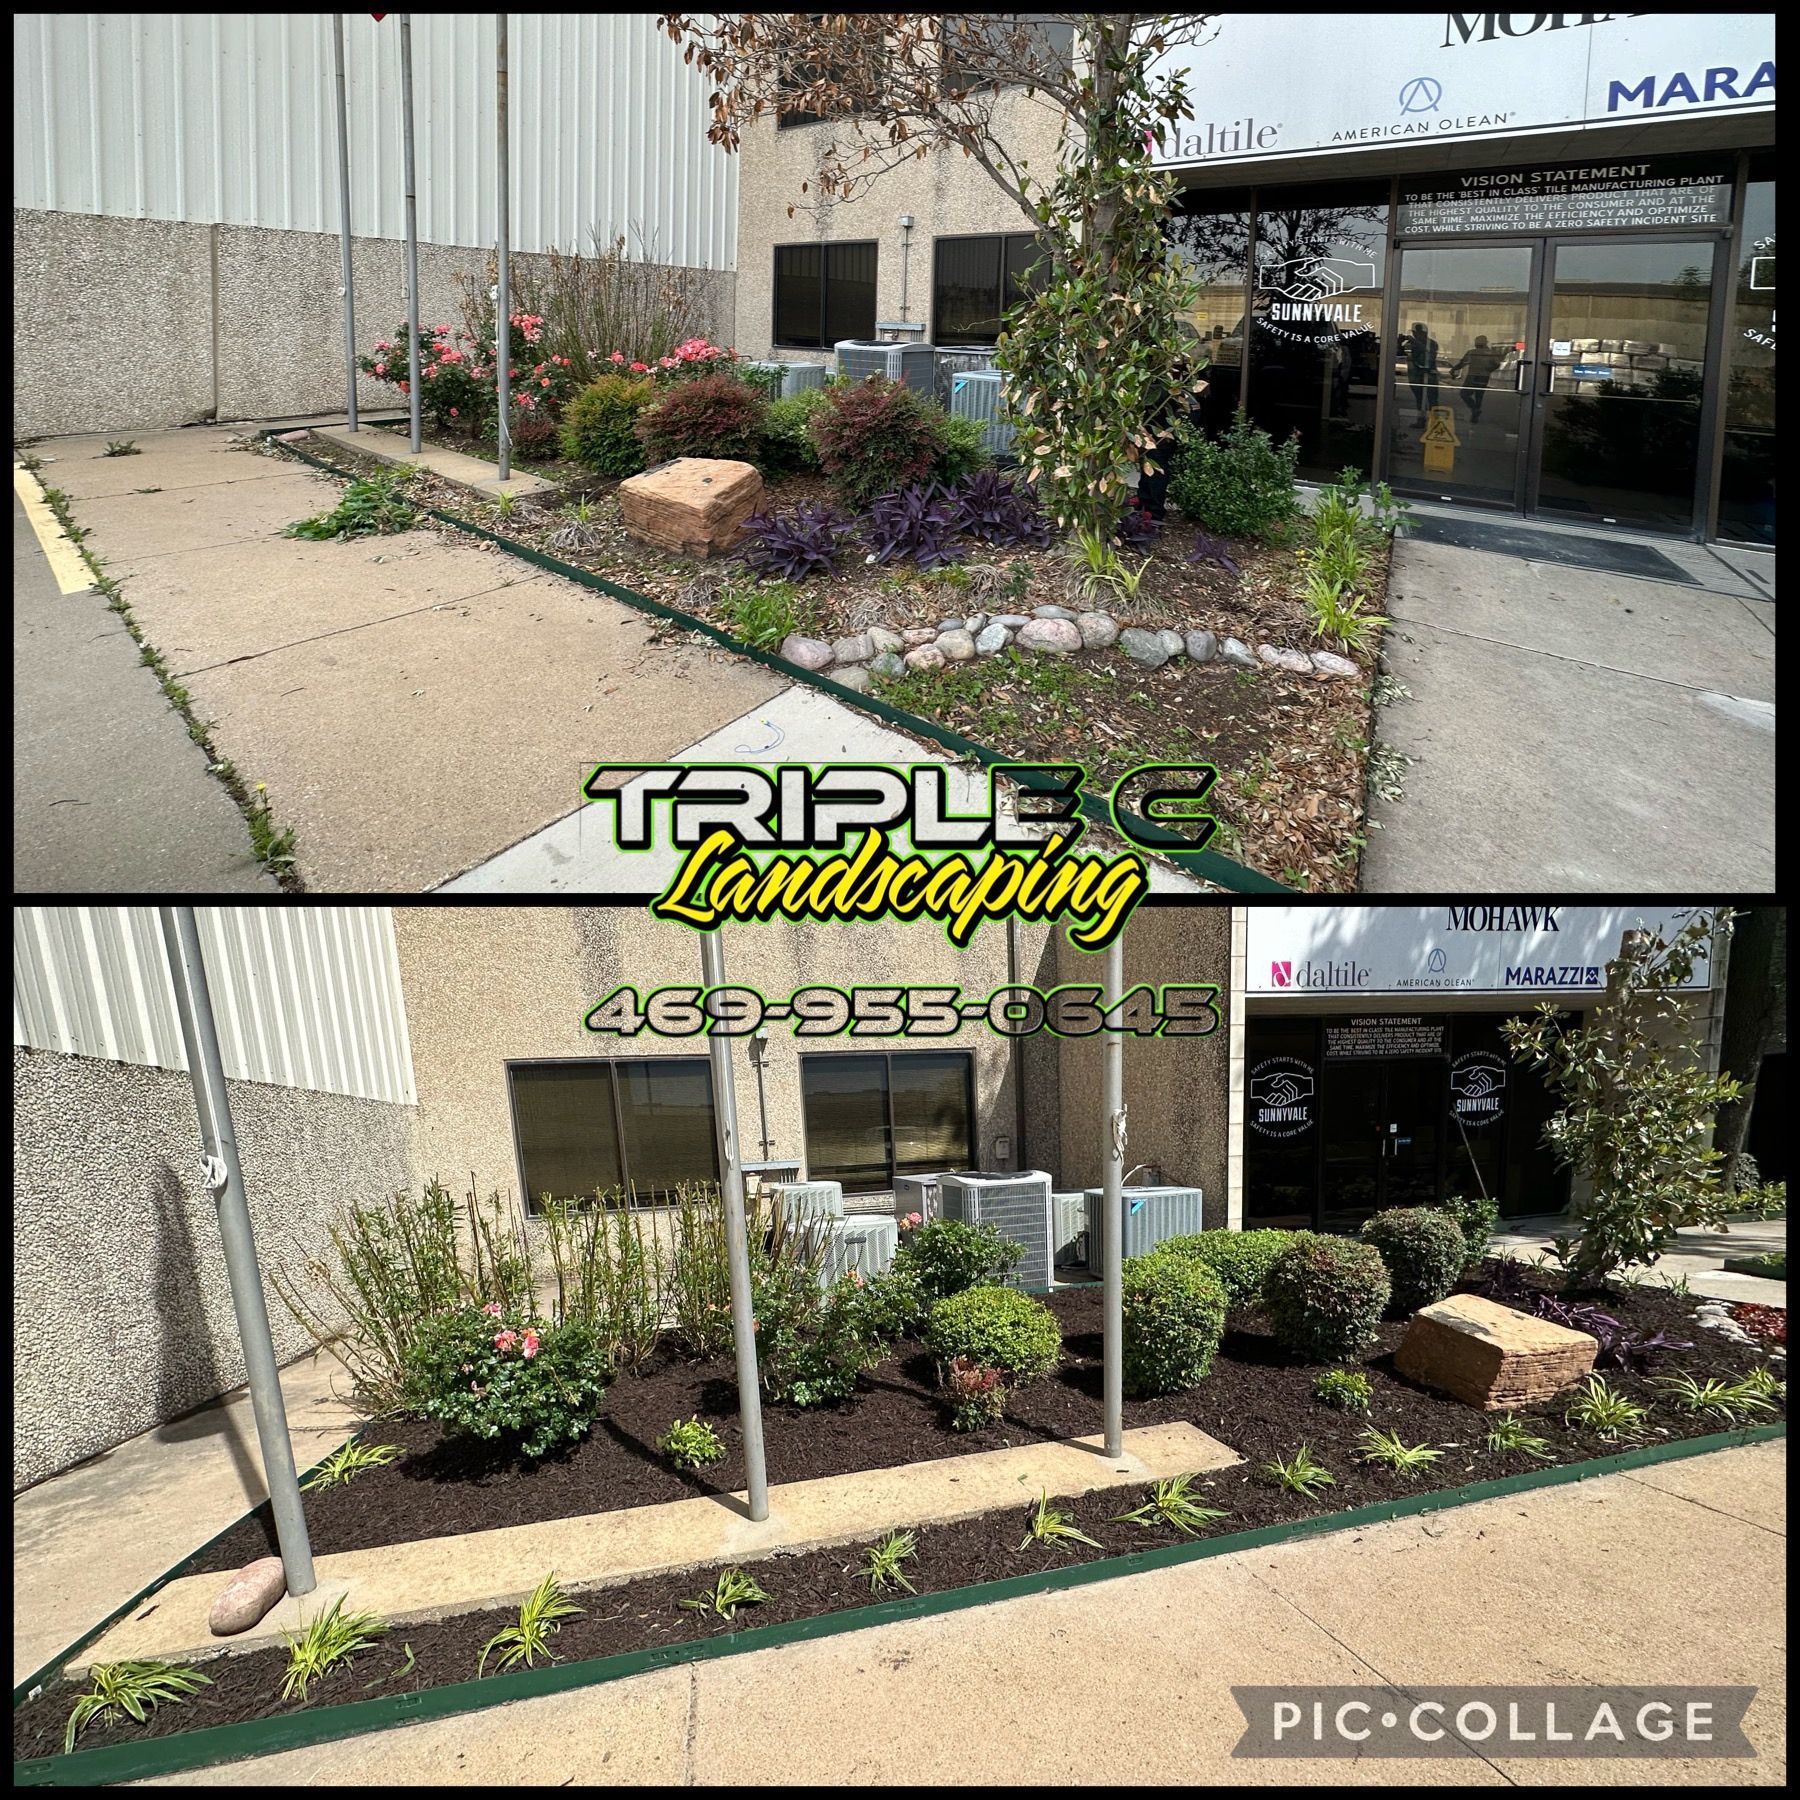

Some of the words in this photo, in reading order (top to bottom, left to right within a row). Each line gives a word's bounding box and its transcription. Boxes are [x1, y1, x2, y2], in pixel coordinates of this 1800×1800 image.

[1332, 122, 1429, 141] AMERICAN
[1439, 113, 1507, 130] OLEAN
[1461, 173, 1523, 187] VISION
[1531, 165, 1650, 183] STATEMENT
[1544, 185, 1567, 193] TILE
[1572, 178, 1675, 191] MANUFACTURING
[1681, 175, 1724, 185] PLANT
[1430, 208, 1471, 216] HIGHEST
[1475, 205, 1519, 214] QUALITY
[1524, 204, 1538, 212] TO
[1568, 199, 1634, 210] CONSUMER
[1638, 198, 1665, 206] AND
[1669, 197, 1685, 205] AT
[1689, 195, 1716, 203] THE
[1436, 197, 1512, 207] CONSISTENTLY
[1515, 194, 1567, 203] DELIVERS
[1571, 191, 1627, 201] PRODUCT
[1669, 187, 1694, 195] ARE
[1412, 217, 1437, 225] SAME
[1470, 214, 1520, 222] MAXIMIZE
[1549, 209, 1613, 220] EFFICIENCY
[1617, 208, 1643, 216] AND
[1648, 205, 1708, 215] OPTIMIZE
[1465, 222, 1508, 231] STRIVING
[1556, 219, 1583, 228] ZERO
[1587, 217, 1628, 226] SAFETY
[1632, 215, 1687, 225] INCIDENT
[1691, 214, 1717, 223] SITE
[1339, 239, 1361, 251] WITH
[1363, 249, 1378, 258] ME
[1272, 303, 1362, 322] SUNNYVALE
[1256, 318, 1289, 338] SAFETY
[1291, 334, 1302, 342] IS
[1314, 333, 1341, 343] CORE
[1342, 321, 1375, 339] VALUE
[1446, 907, 1560, 932] MOHAWK
[1296, 961, 1369, 987] daltile
[1397, 979, 1441, 987] AMERICAN
[1505, 967, 1584, 985] MARAZZI
[1251, 1060, 1270, 1075] SAFETY
[1295, 1059, 1307, 1068] WITH
[1259, 1107, 1307, 1122] SUNNYVALE
[1457, 1098, 1499, 1112] SUNNYVALE
[1250, 1121, 1269, 1135] SAFETY
[1283, 1129, 1296, 1137] CORE
[1298, 1119, 1314, 1132] VALUE
